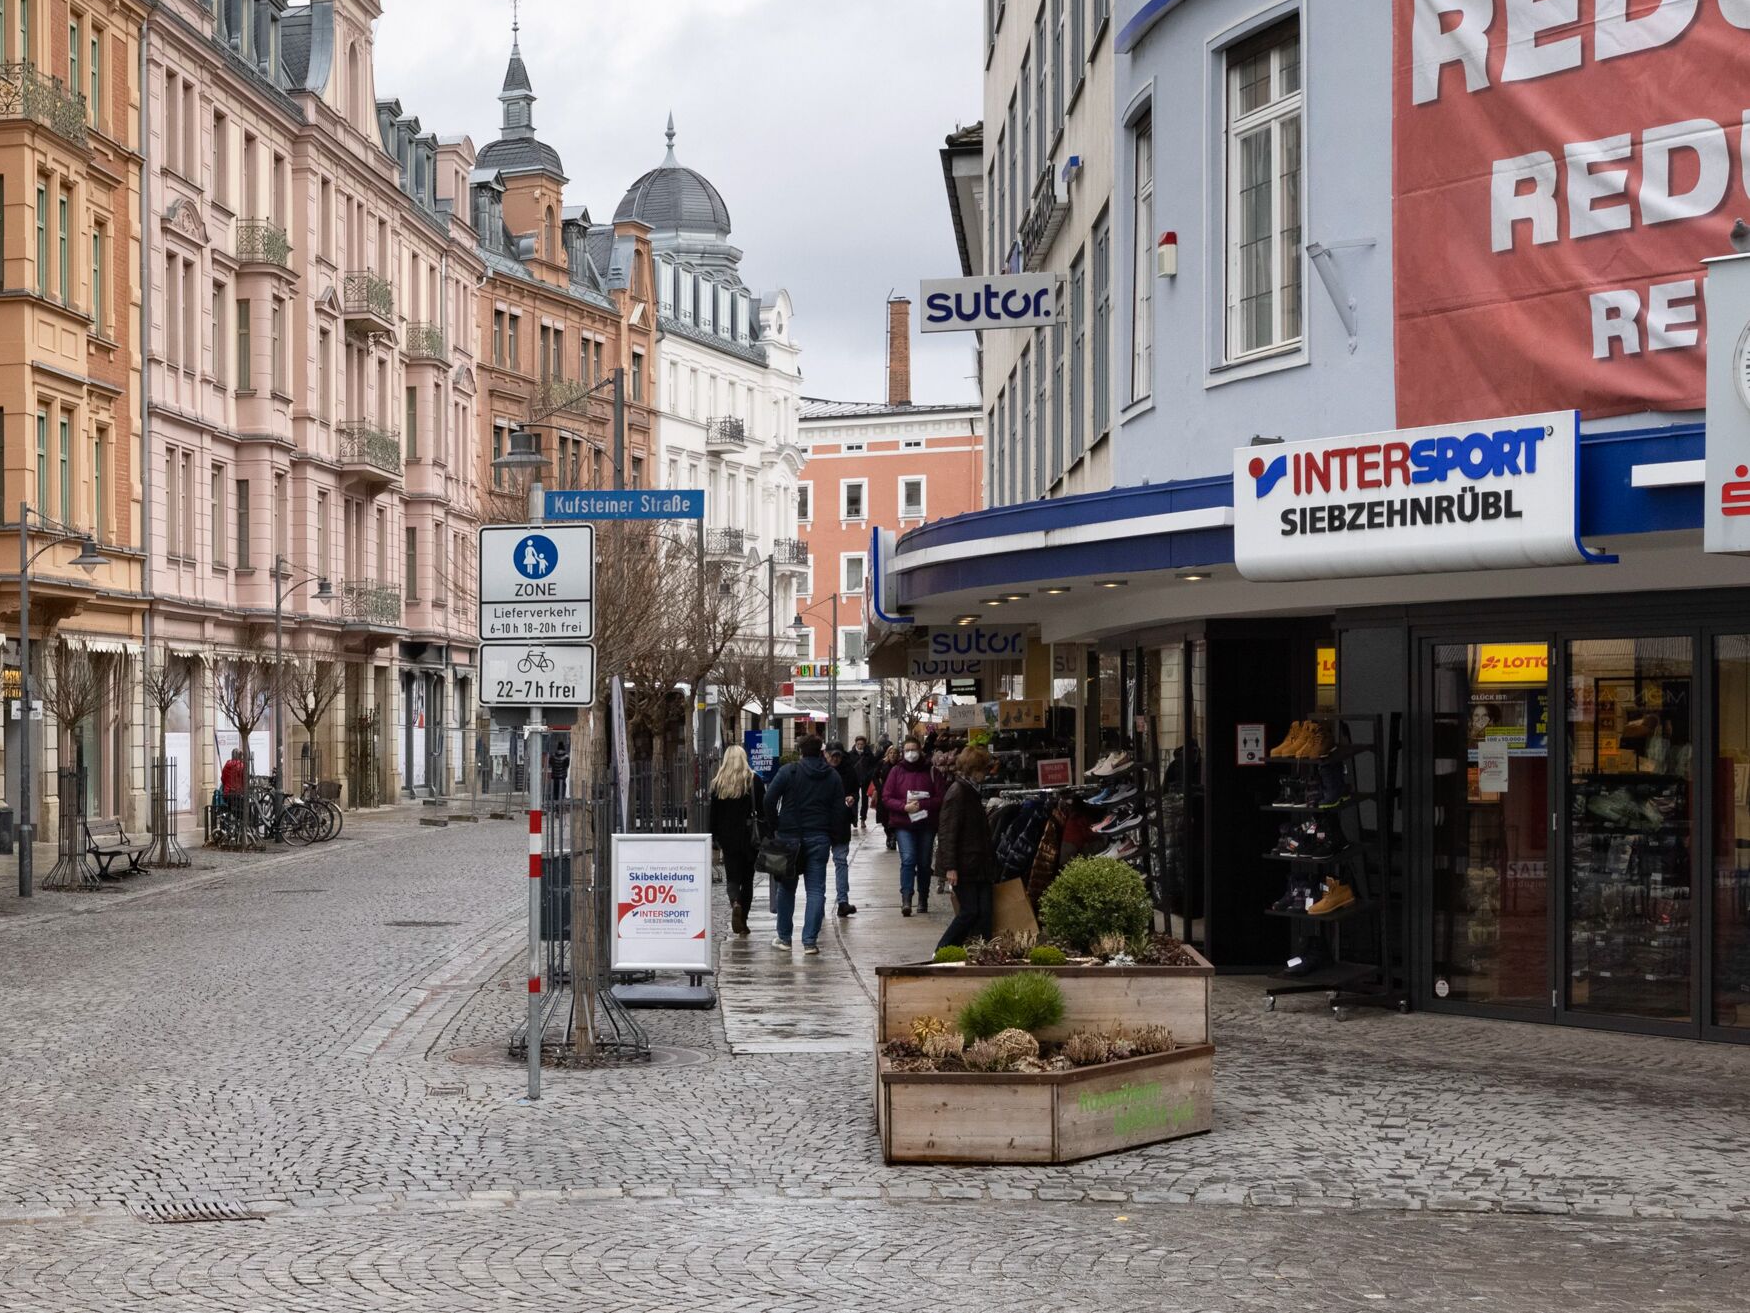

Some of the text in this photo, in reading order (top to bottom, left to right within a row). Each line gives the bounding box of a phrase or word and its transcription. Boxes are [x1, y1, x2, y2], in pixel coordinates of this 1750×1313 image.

[1490, 110, 1750, 253] RED
[1590, 276, 1706, 359] RE
[1293, 426, 1546, 496] INTERSPORT
[554, 494, 691, 514] Kufsteiner Straße
[1279, 486, 1523, 536] SIEBZEHNRÜBL
[515, 583, 557, 597] ZONE
[494, 606, 577, 619] Lieferverkehr
[561, 621, 582, 633] frei
[496, 680, 533, 698] 22-7
[549, 680, 576, 698] frei
[629, 872, 694, 883] Skibekleidung
[630, 884, 677, 905] 30%
[639, 910, 690, 919] INTERSPORT
